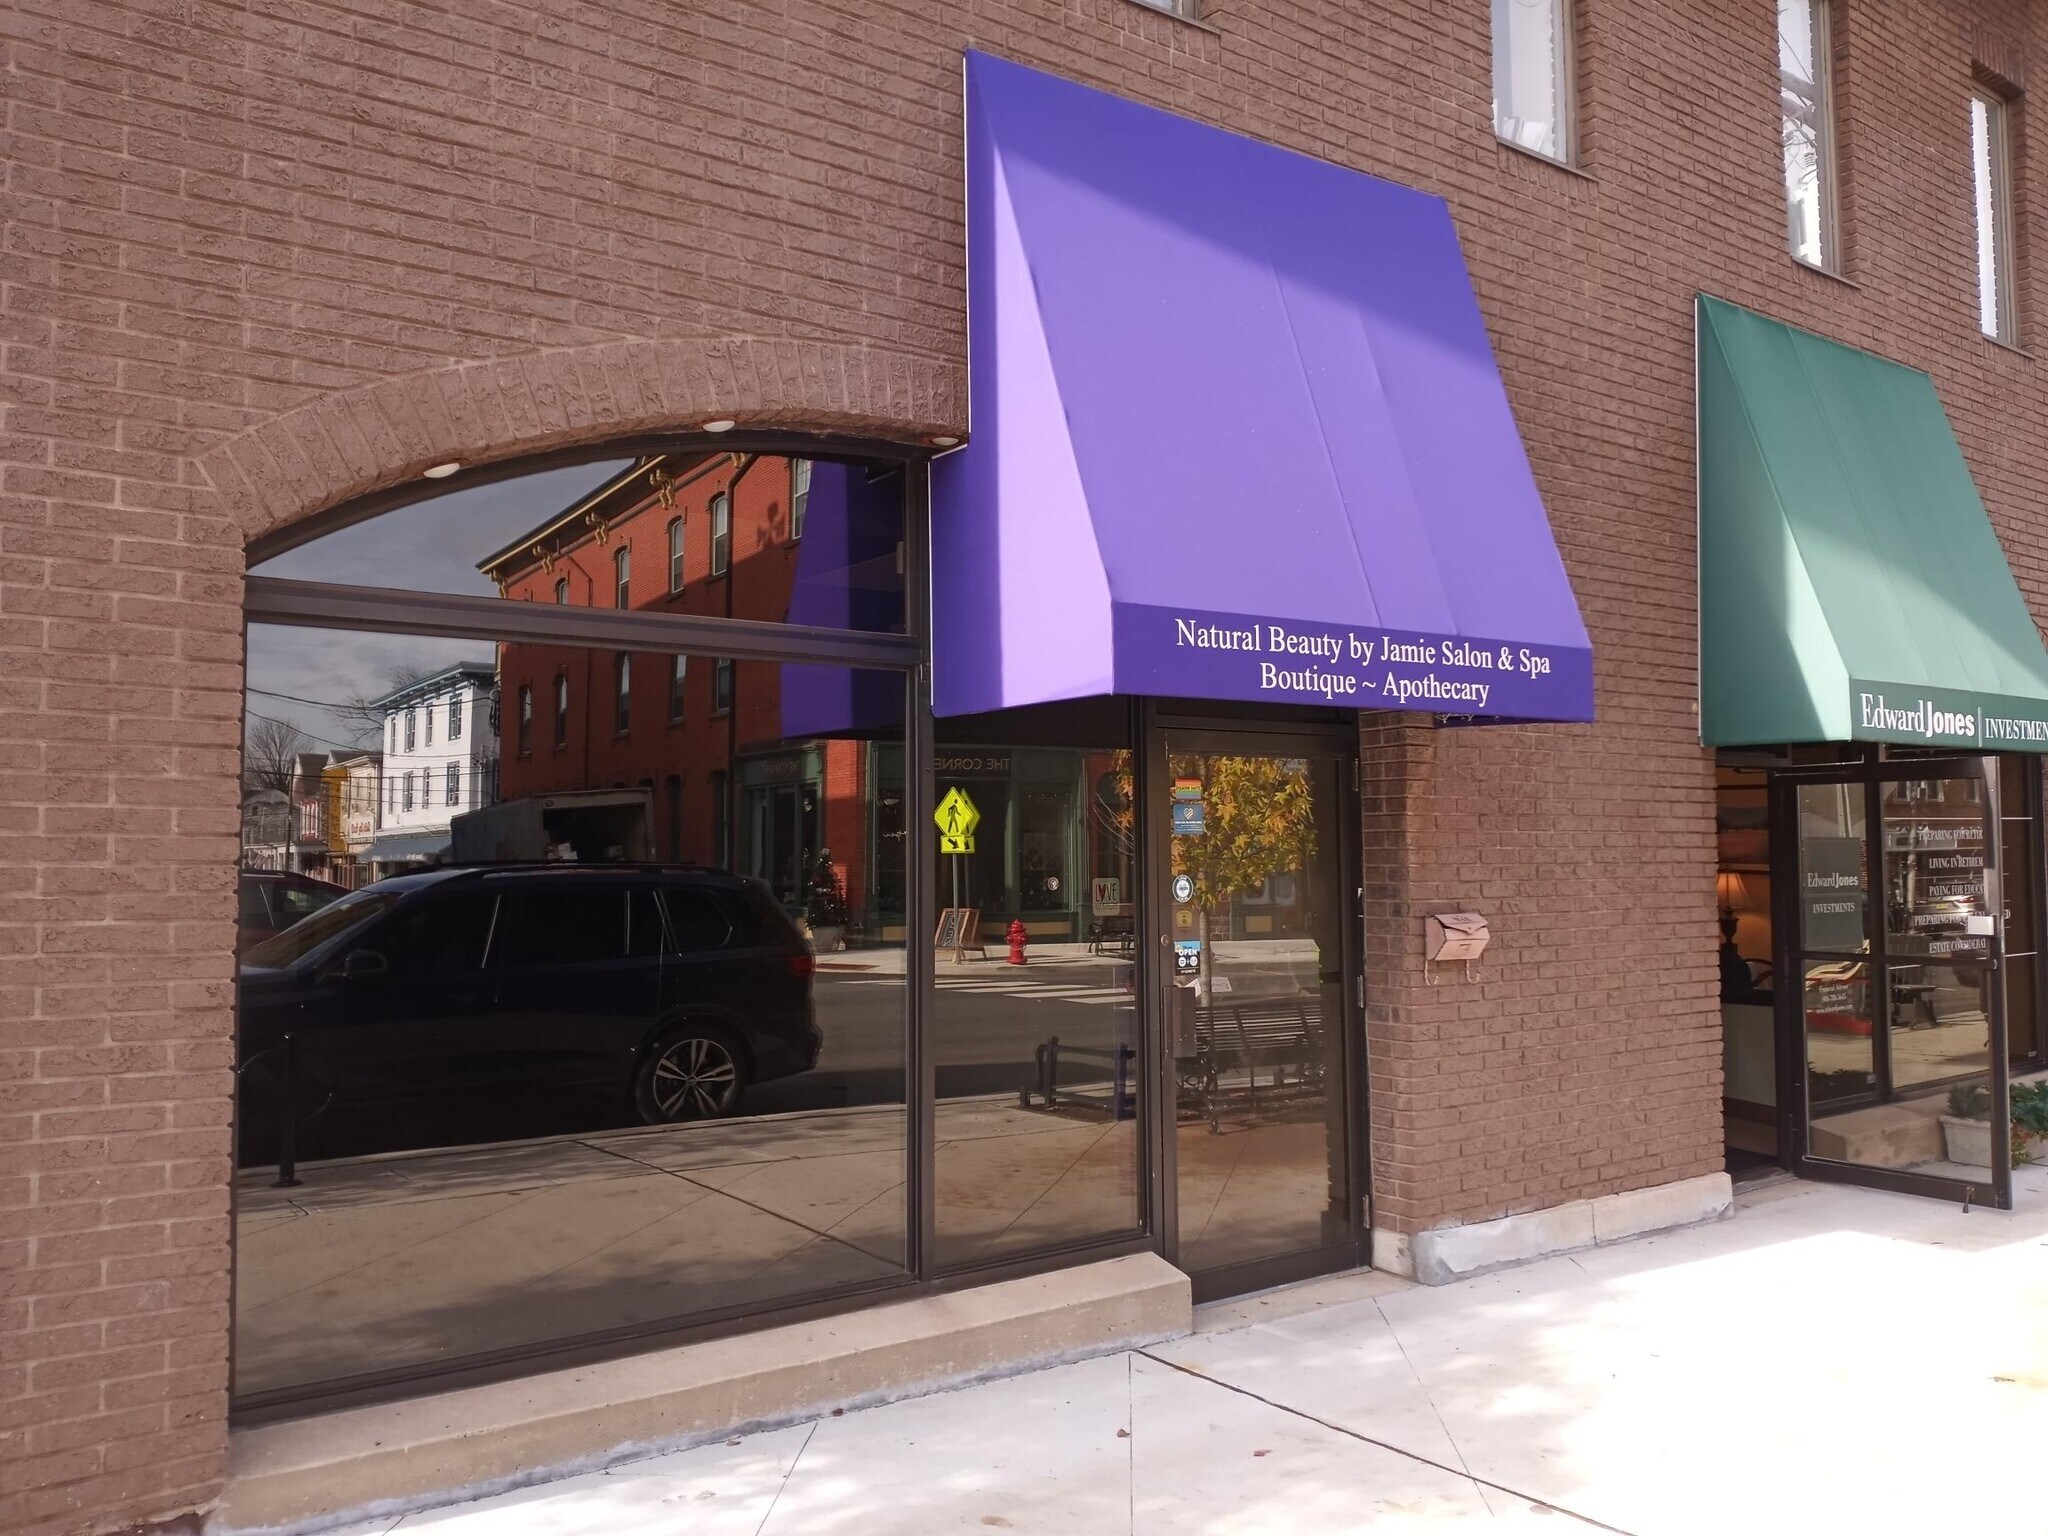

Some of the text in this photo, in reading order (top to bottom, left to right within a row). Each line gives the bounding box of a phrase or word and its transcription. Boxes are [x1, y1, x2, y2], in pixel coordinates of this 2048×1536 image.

[1175, 618, 1551, 679] Natural Beauty by Jamie Salon & Spa
[1259, 662, 1356, 700] Boutique
[1382, 672, 1490, 708] Apothecary
[1920, 829, 1953, 840] PREPARING
[1929, 858, 1950, 869] LIVING
[1950, 857, 1958, 868] IN
[1929, 884, 1951, 896] PAYING
[1951, 884, 1964, 895] FOR
[1813, 902, 1855, 913] INVESTMENTS
[1914, 914, 1948, 926] PREPARING
[1929, 942, 1951, 954] ESTATE
